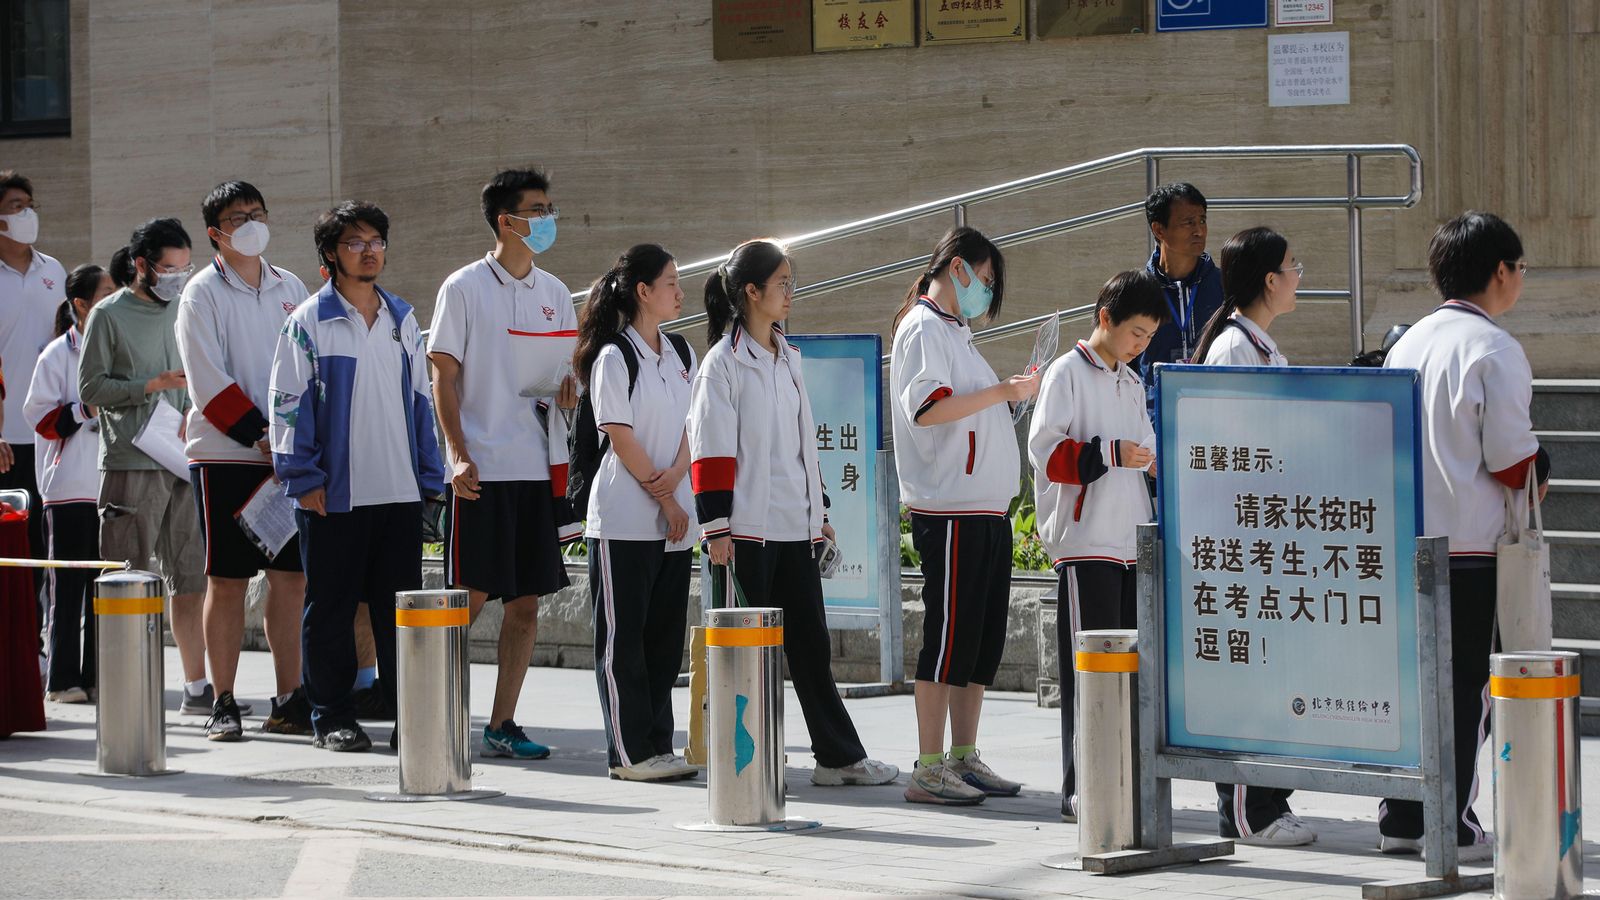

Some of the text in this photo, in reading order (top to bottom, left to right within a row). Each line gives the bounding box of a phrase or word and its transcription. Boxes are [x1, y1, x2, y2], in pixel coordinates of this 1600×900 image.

[838, 10, 889, 30] 校友会
[1304, 3, 1325, 11] 12345
[816, 423, 858, 451] 生出
[1189, 445, 1284, 473] 温馨提示：
[841, 463, 861, 492] 身
[1234, 493, 1377, 534] 请家长按时
[1191, 536, 1384, 580] 接送考生，不要
[1193, 581, 1382, 625] 在考点大门口
[1194, 628, 1268, 664] 逗留！
